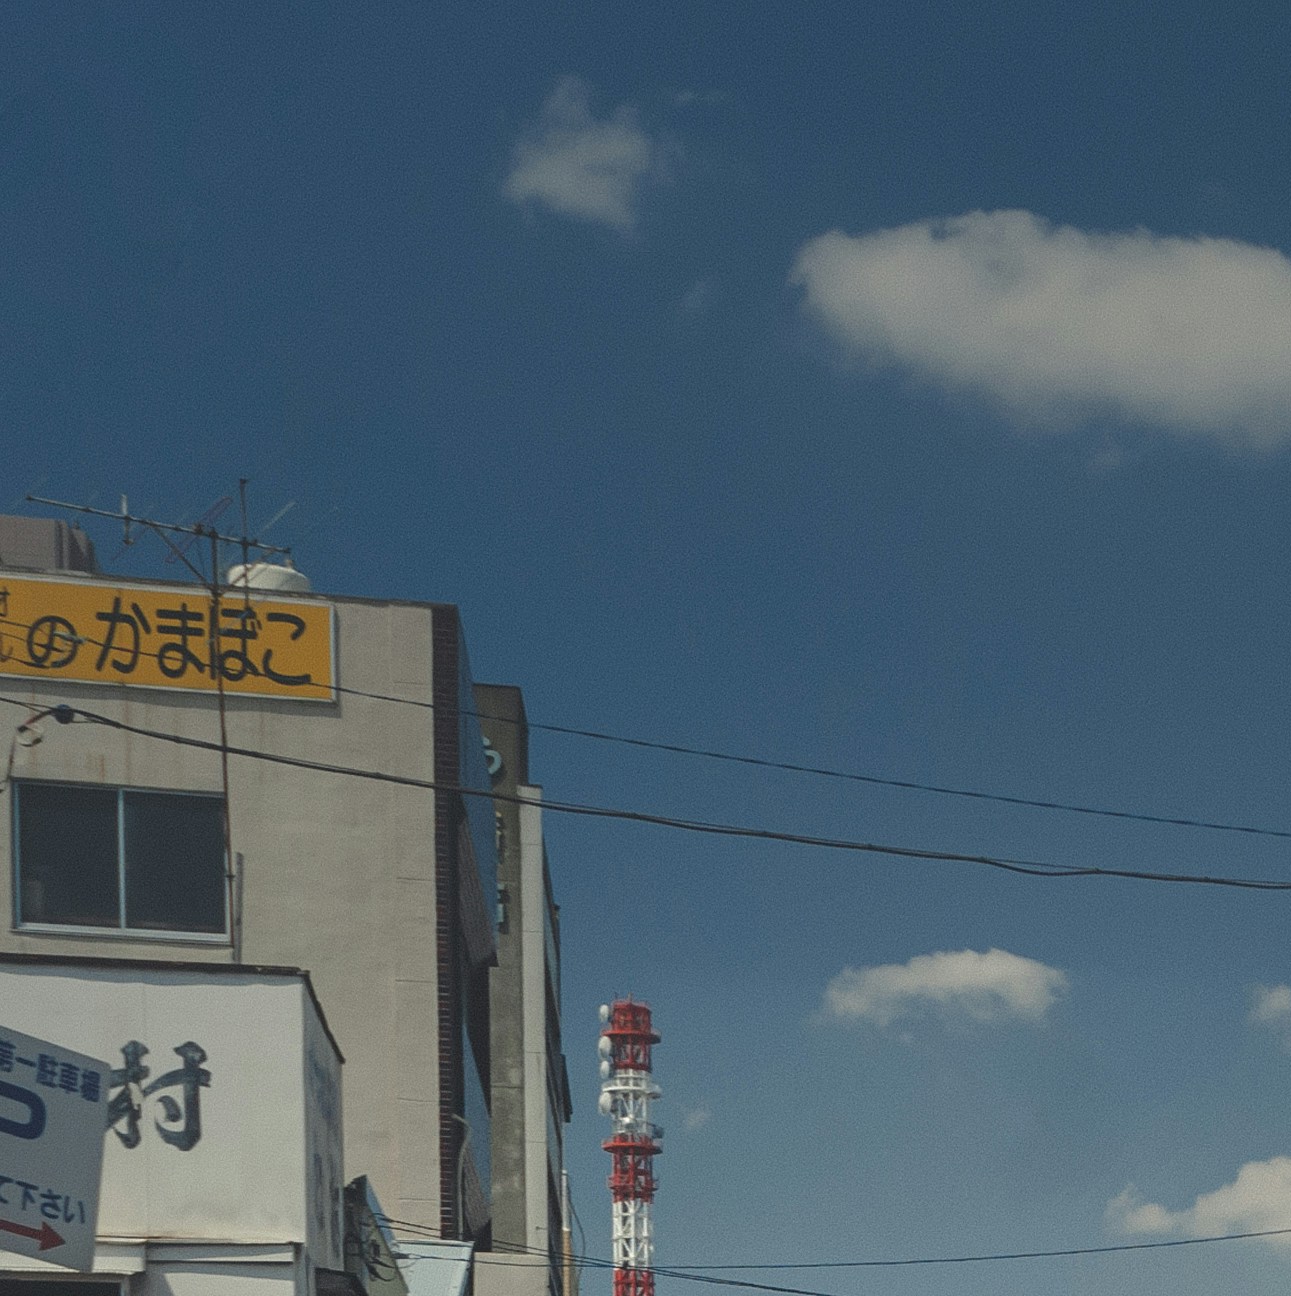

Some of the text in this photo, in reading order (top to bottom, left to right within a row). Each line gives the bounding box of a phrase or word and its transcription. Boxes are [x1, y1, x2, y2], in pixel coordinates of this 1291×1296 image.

[27, 596, 312, 686] のかまぼこ
[107, 1040, 212, 1151] 村
